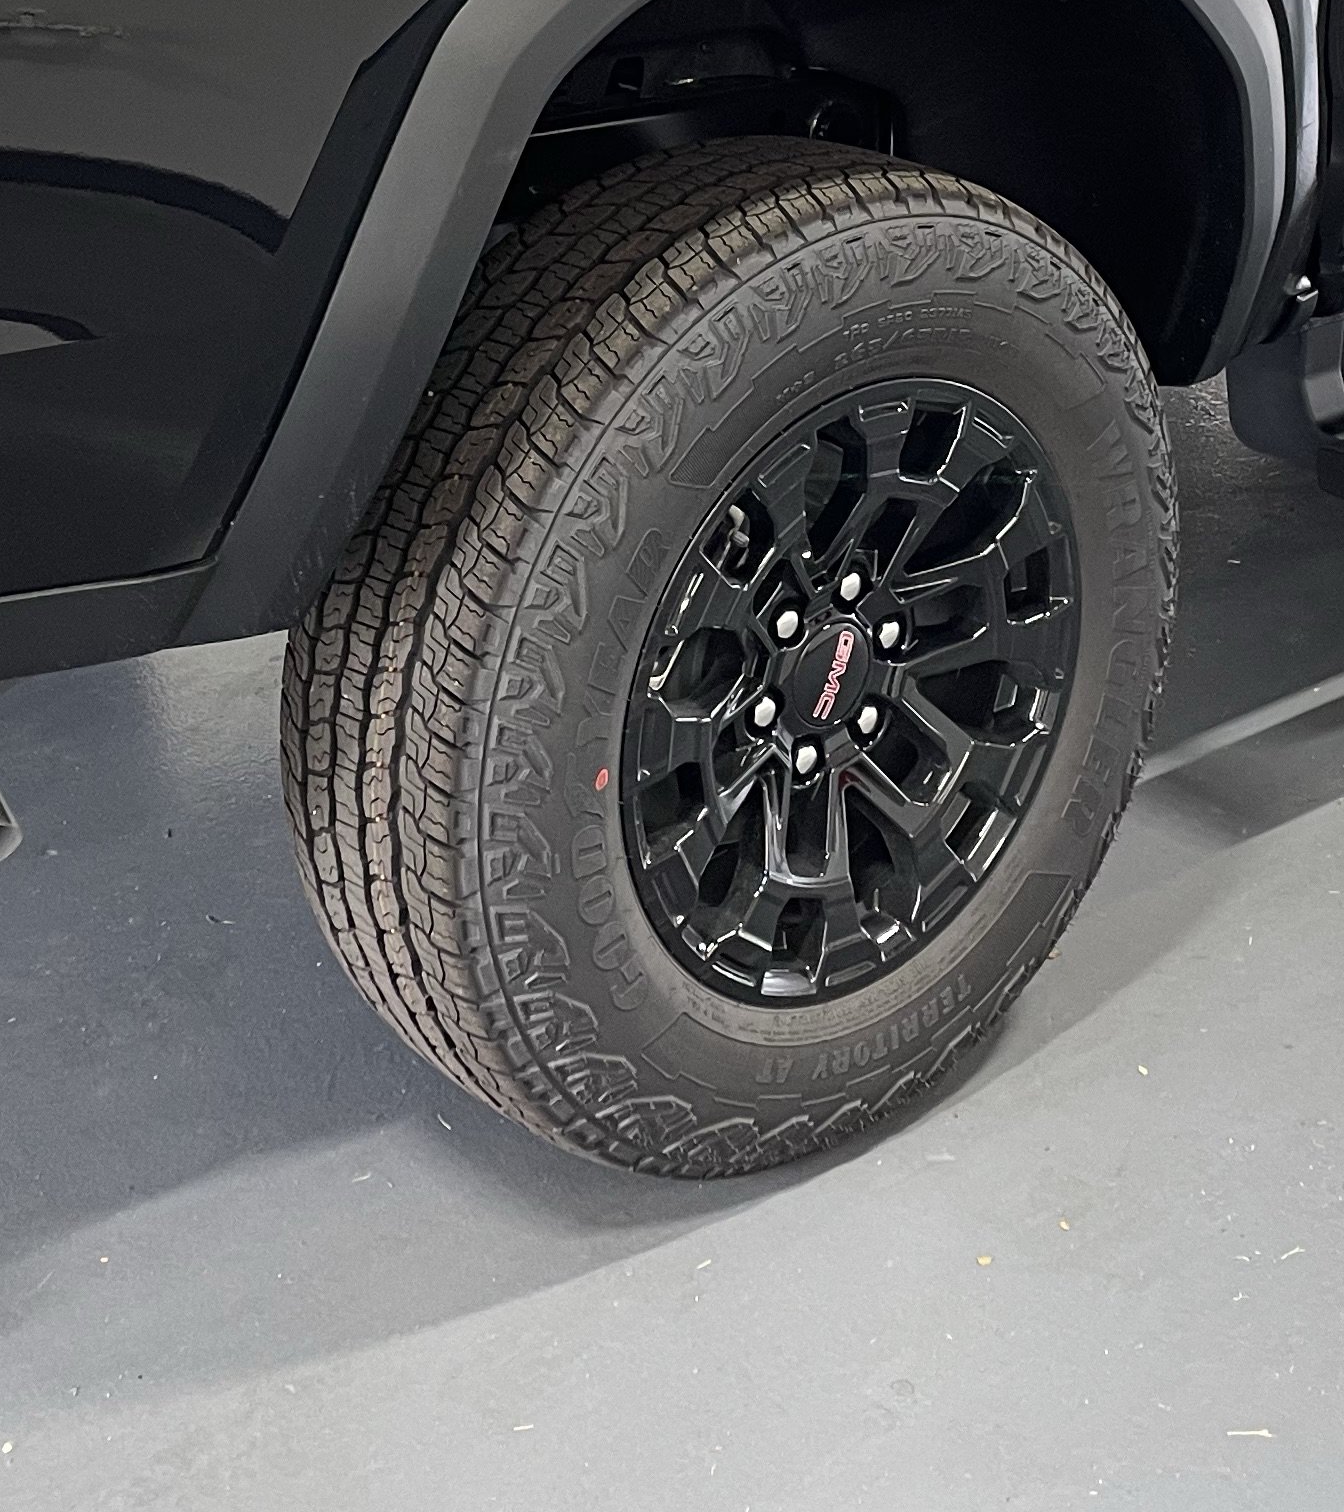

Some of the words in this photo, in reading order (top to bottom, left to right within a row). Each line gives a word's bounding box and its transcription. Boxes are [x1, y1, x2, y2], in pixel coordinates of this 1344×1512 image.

[812, 630, 855, 720] GMC
[1061, 419, 1155, 836] WRANGLER
[567, 527, 671, 1011] GOODYEAR
[757, 1051, 794, 1084] AT
[812, 973, 972, 1081] TERRITORY
